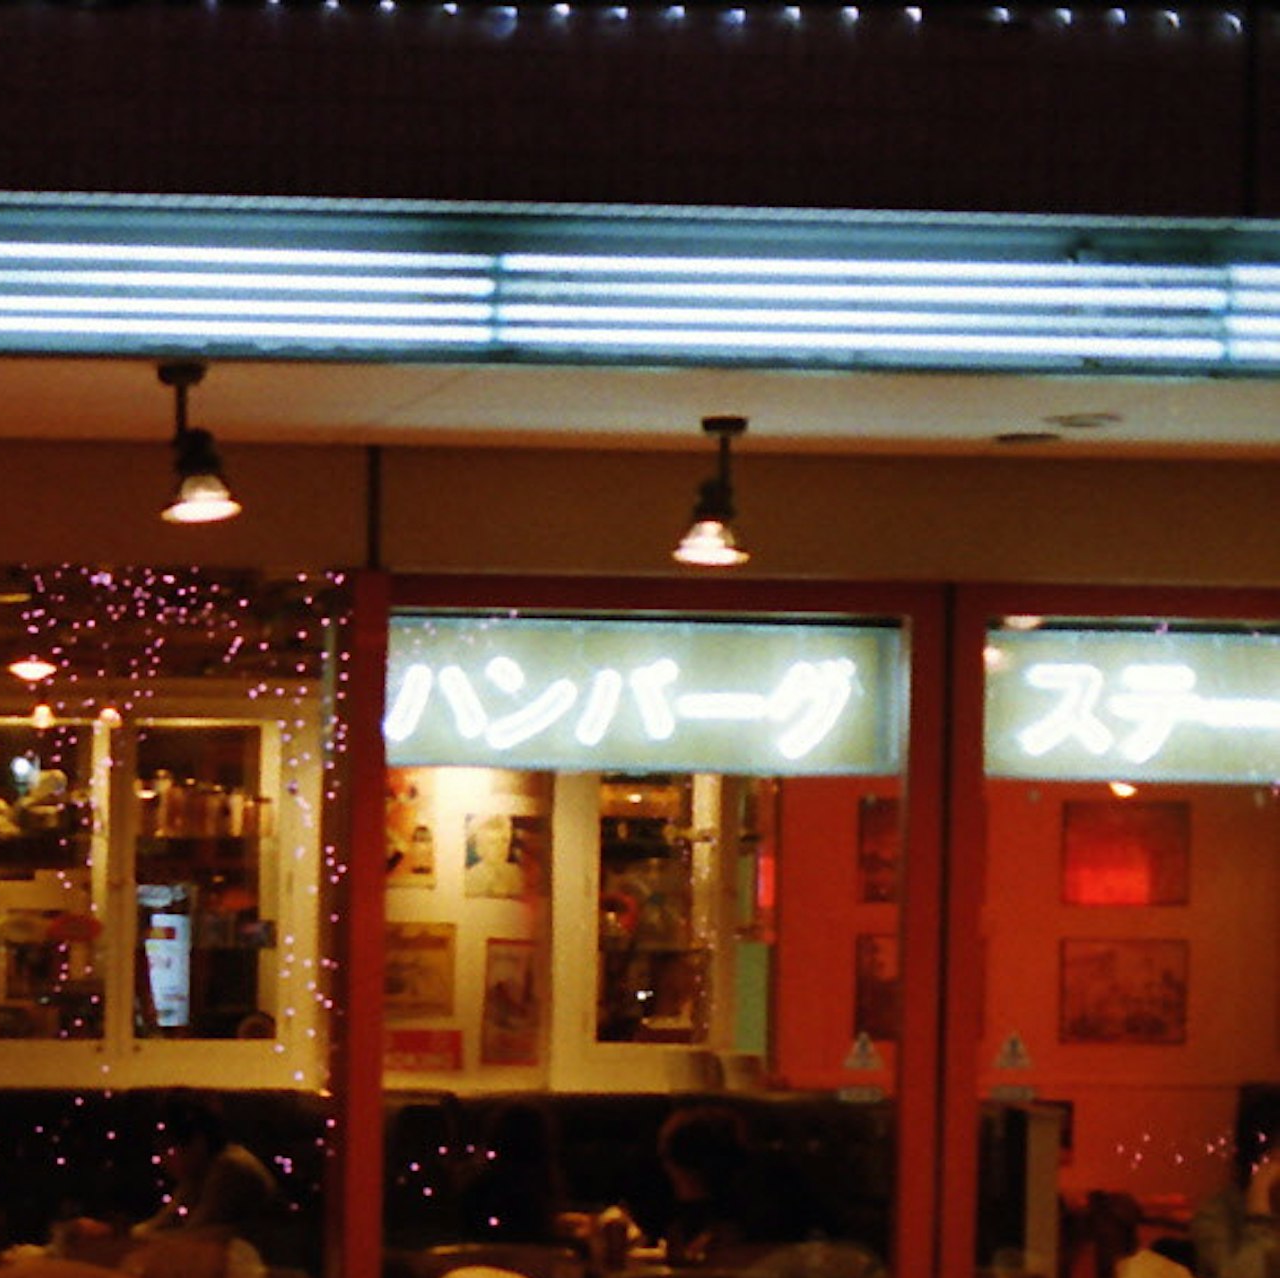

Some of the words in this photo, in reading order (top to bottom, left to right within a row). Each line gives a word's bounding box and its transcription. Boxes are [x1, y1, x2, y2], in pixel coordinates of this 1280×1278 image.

[383, 656, 857, 760] ハンバーグ
